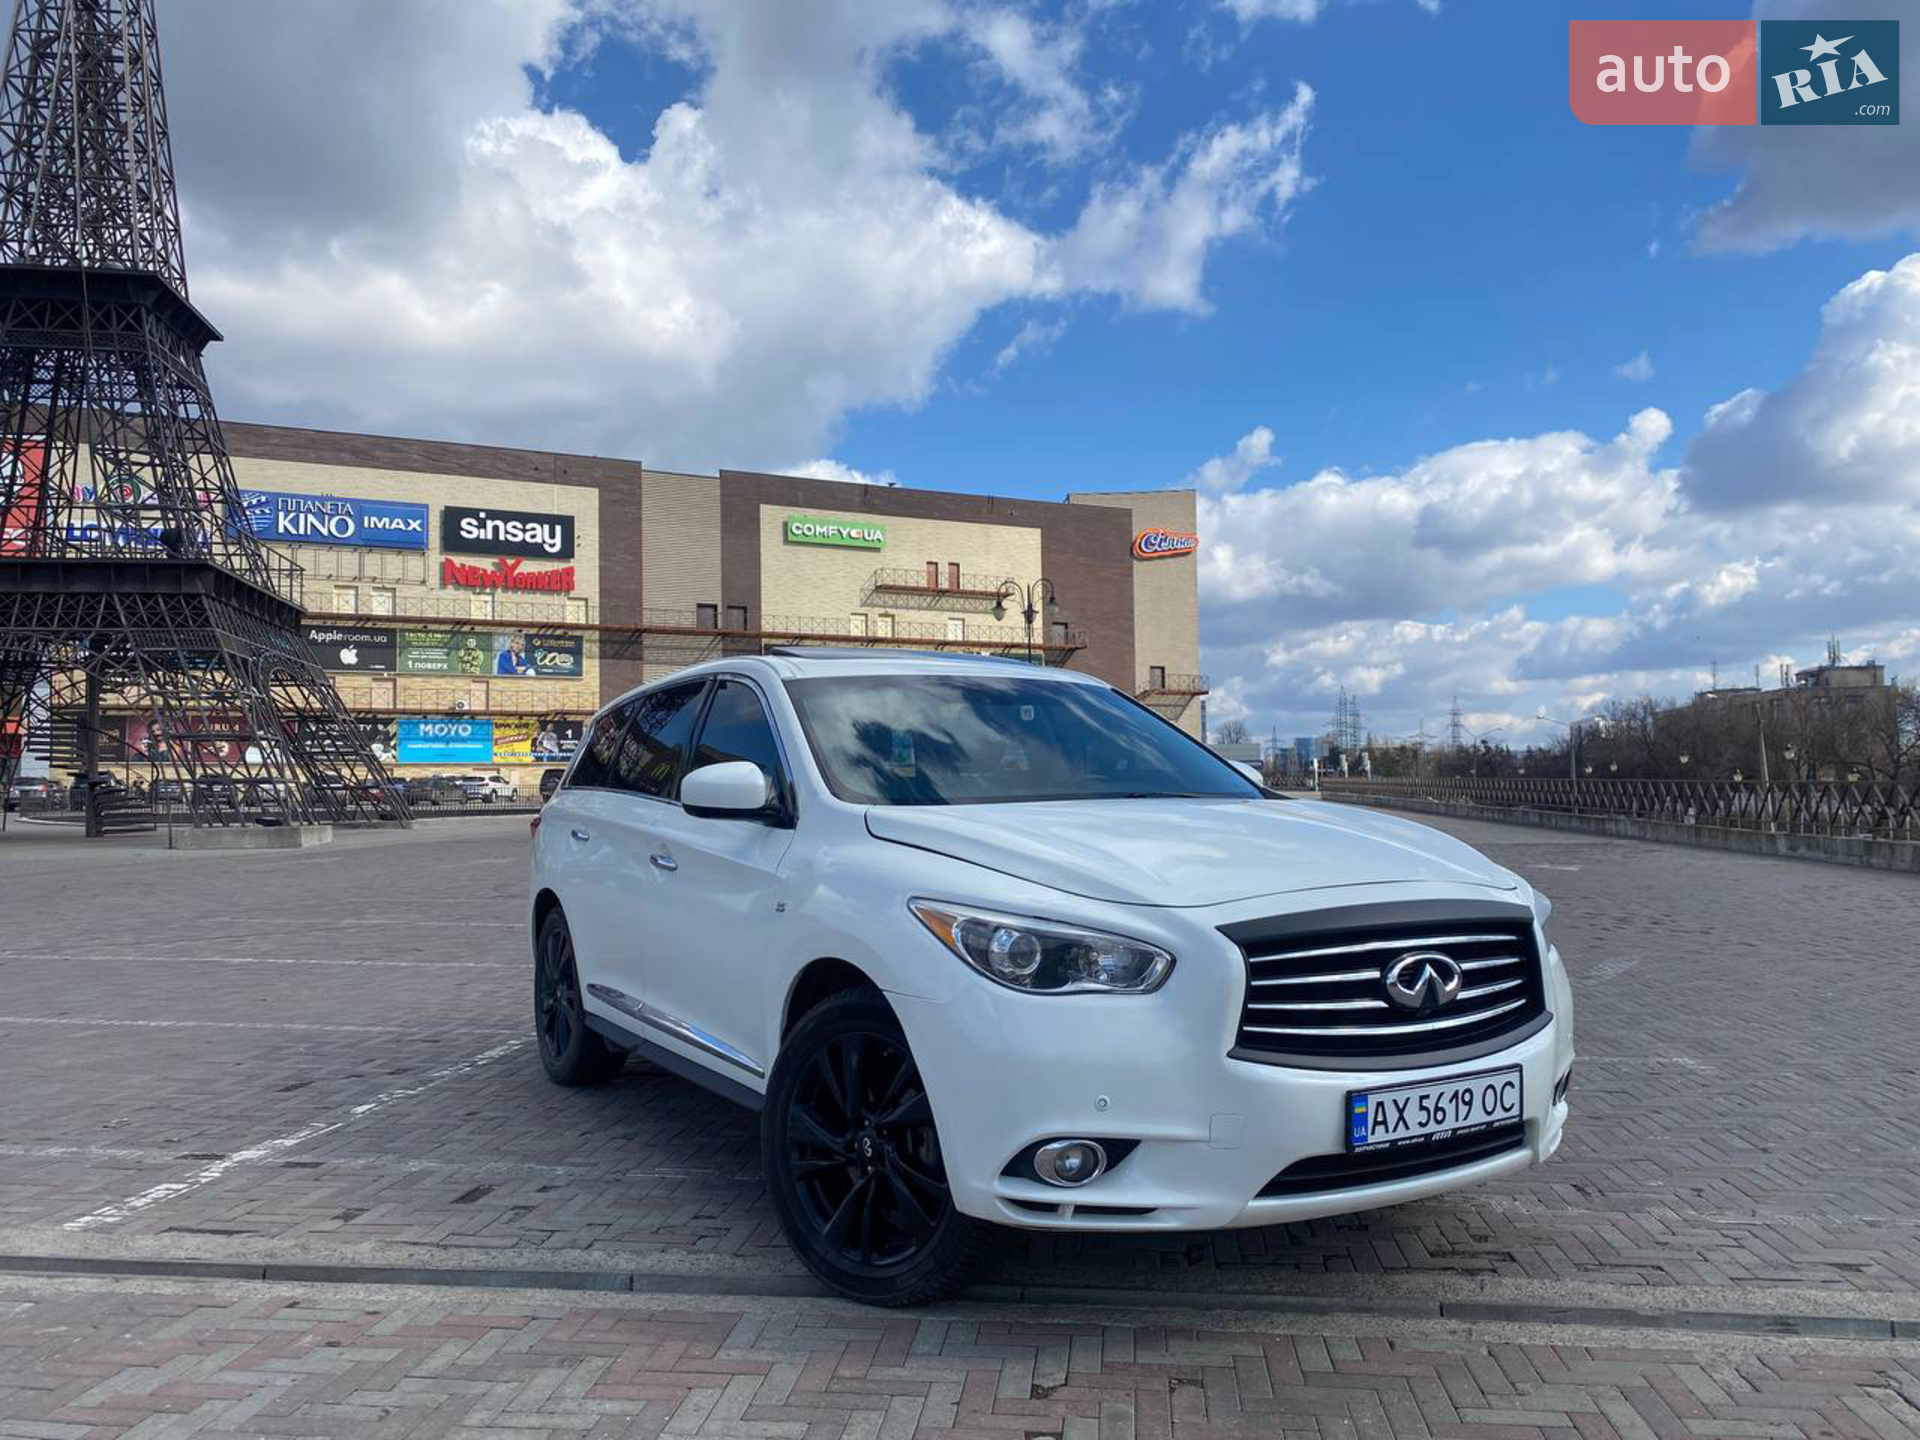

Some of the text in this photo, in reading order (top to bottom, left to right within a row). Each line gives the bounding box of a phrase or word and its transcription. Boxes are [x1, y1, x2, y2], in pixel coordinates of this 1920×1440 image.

[363, 515, 423, 532] IMAX
[459, 512, 562, 553] sinsay
[419, 723, 472, 737] MOYO
[1370, 1080, 1515, 1136] AX 5619 OC
[1353, 1126, 1367, 1138] UA
